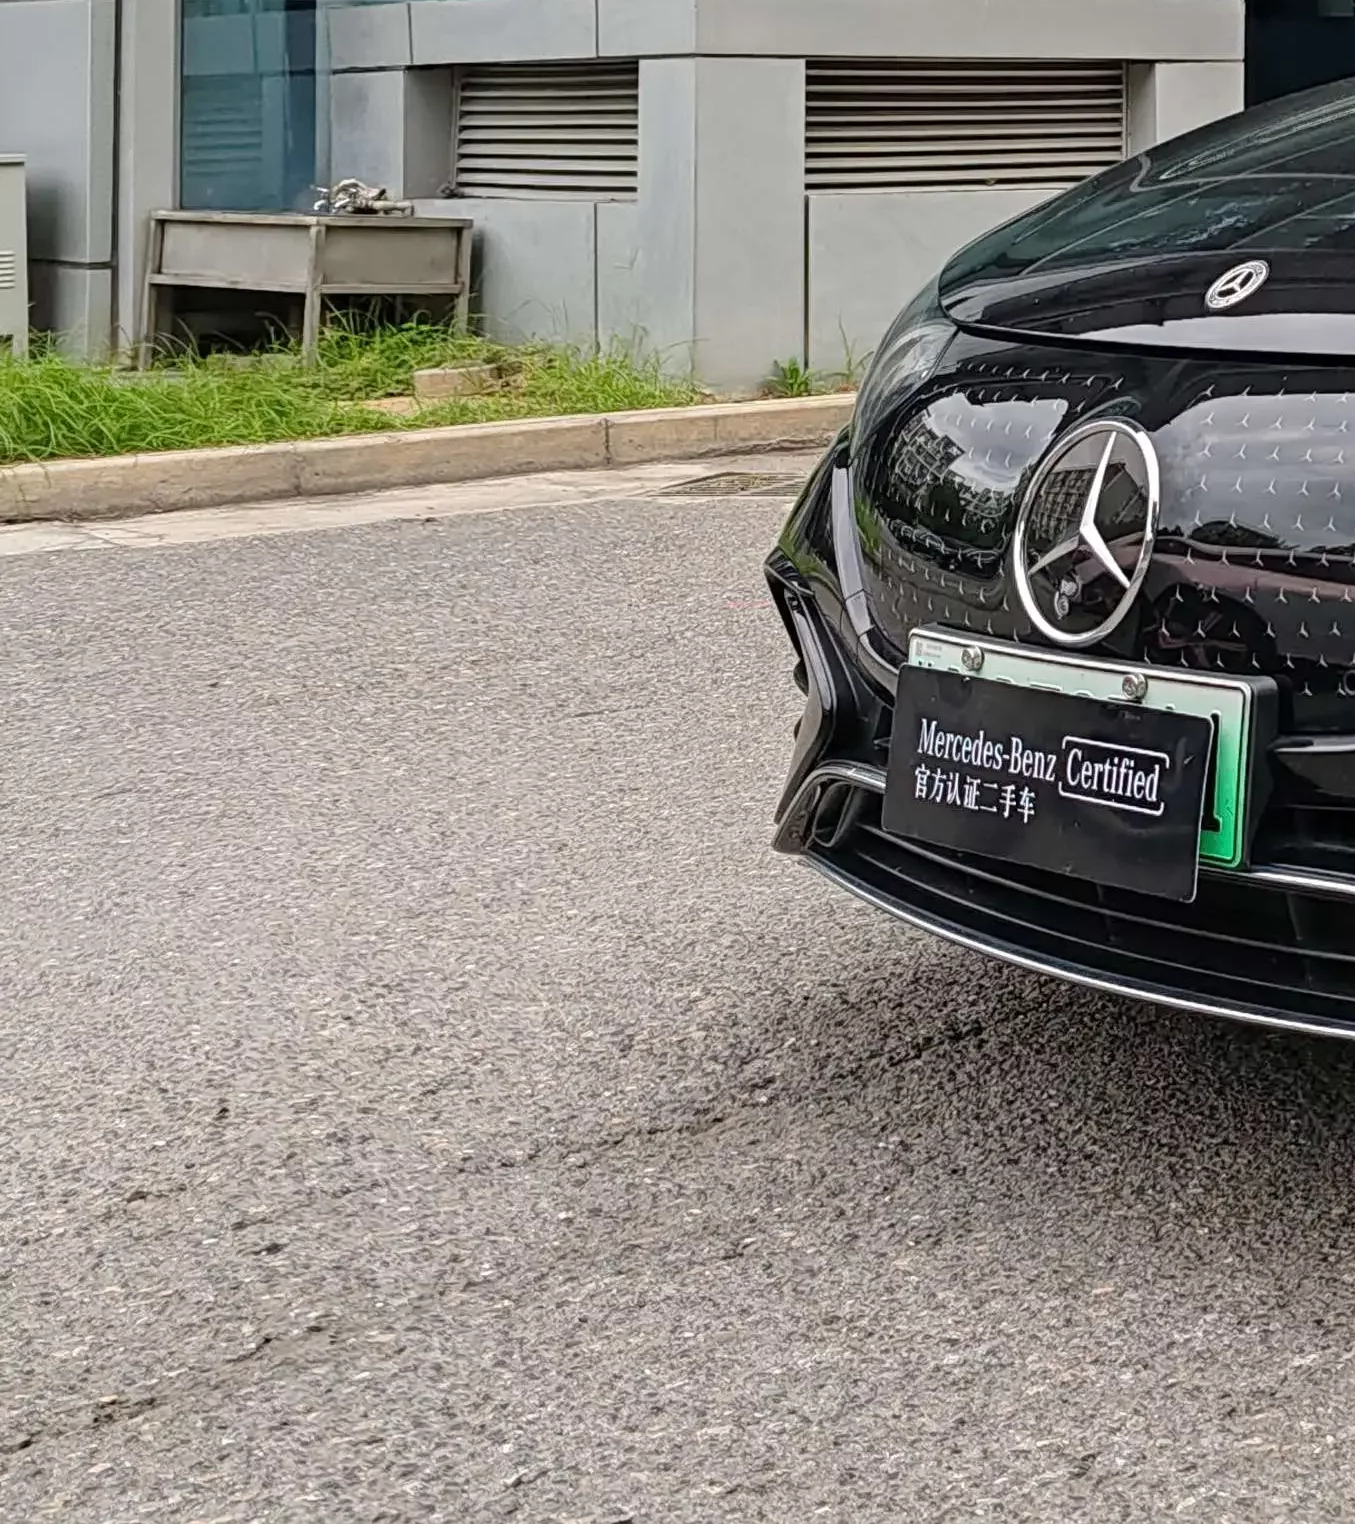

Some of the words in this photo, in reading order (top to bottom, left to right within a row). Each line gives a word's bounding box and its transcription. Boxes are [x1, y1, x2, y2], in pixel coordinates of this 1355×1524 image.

[914, 763, 1037, 825] 官方认证二手车
[917, 717, 1058, 783] Mercedes-Benz
[1066, 747, 1161, 804] Certified
